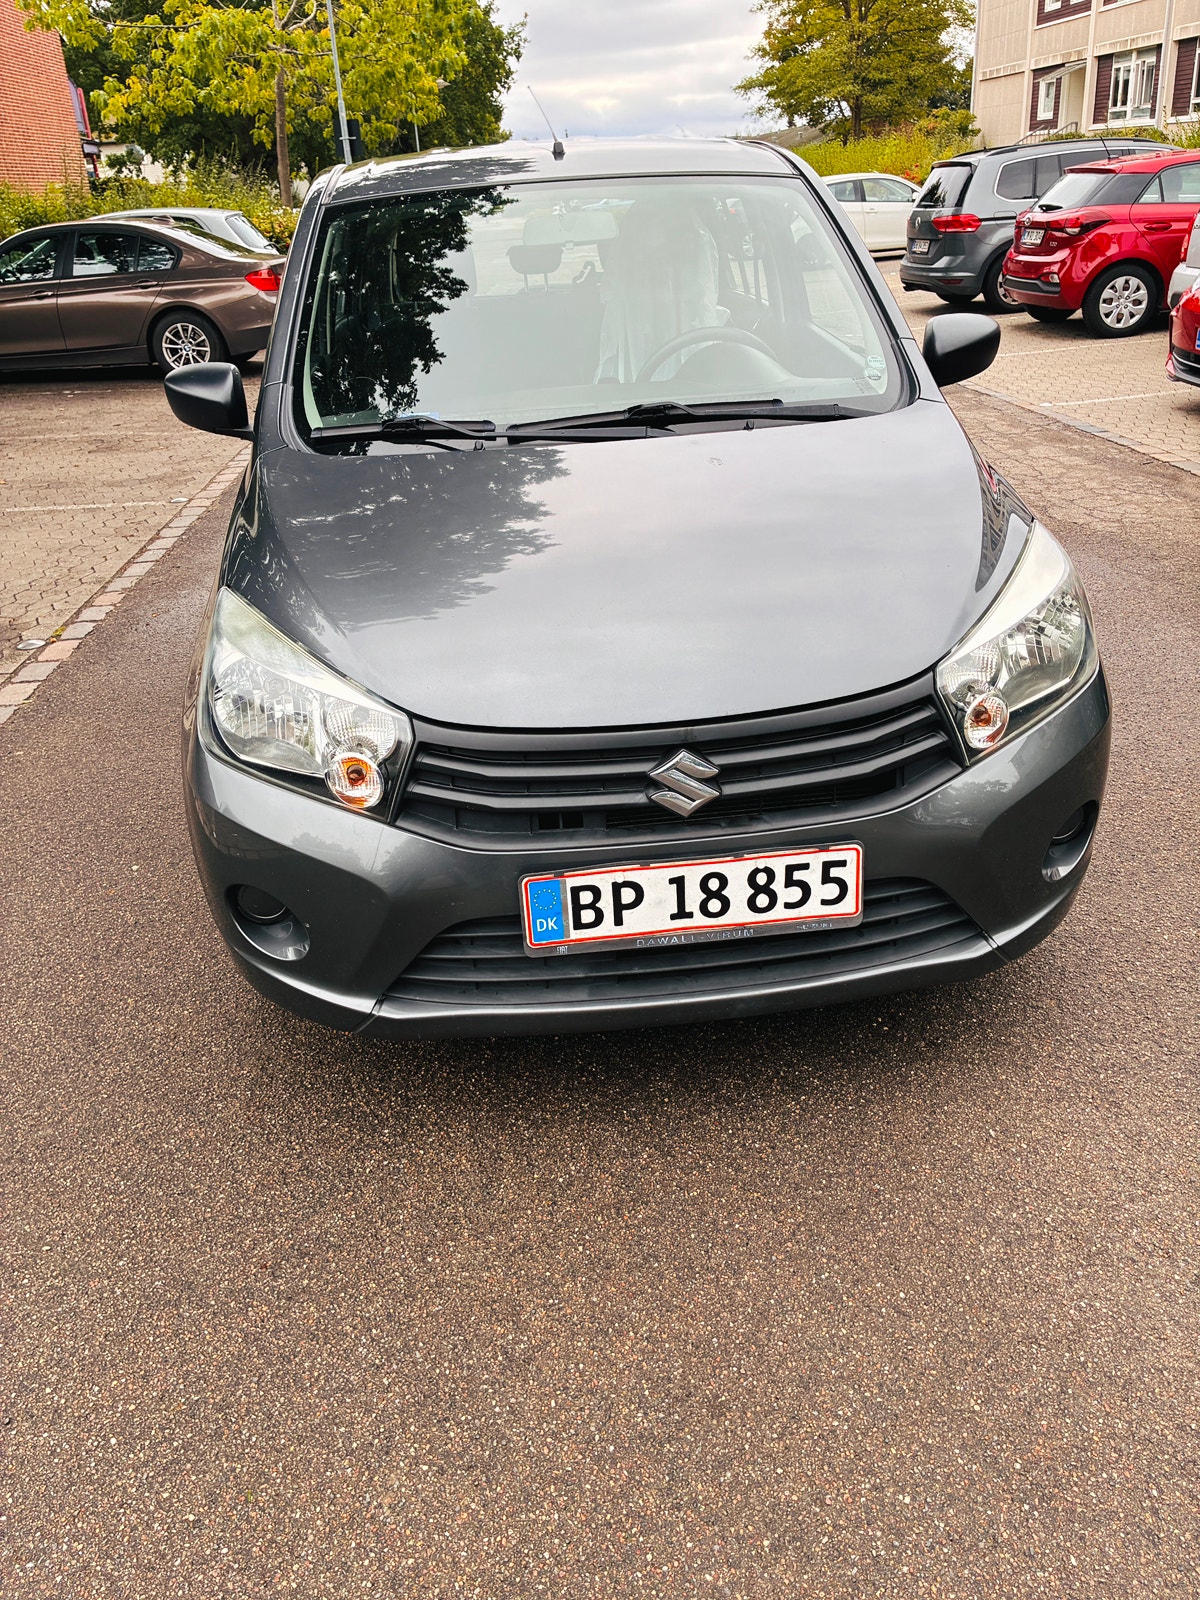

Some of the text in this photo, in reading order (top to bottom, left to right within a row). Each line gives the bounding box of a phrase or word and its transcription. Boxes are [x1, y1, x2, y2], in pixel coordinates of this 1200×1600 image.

[569, 859, 849, 931] BP 18 855
[536, 917, 559, 932] DK
